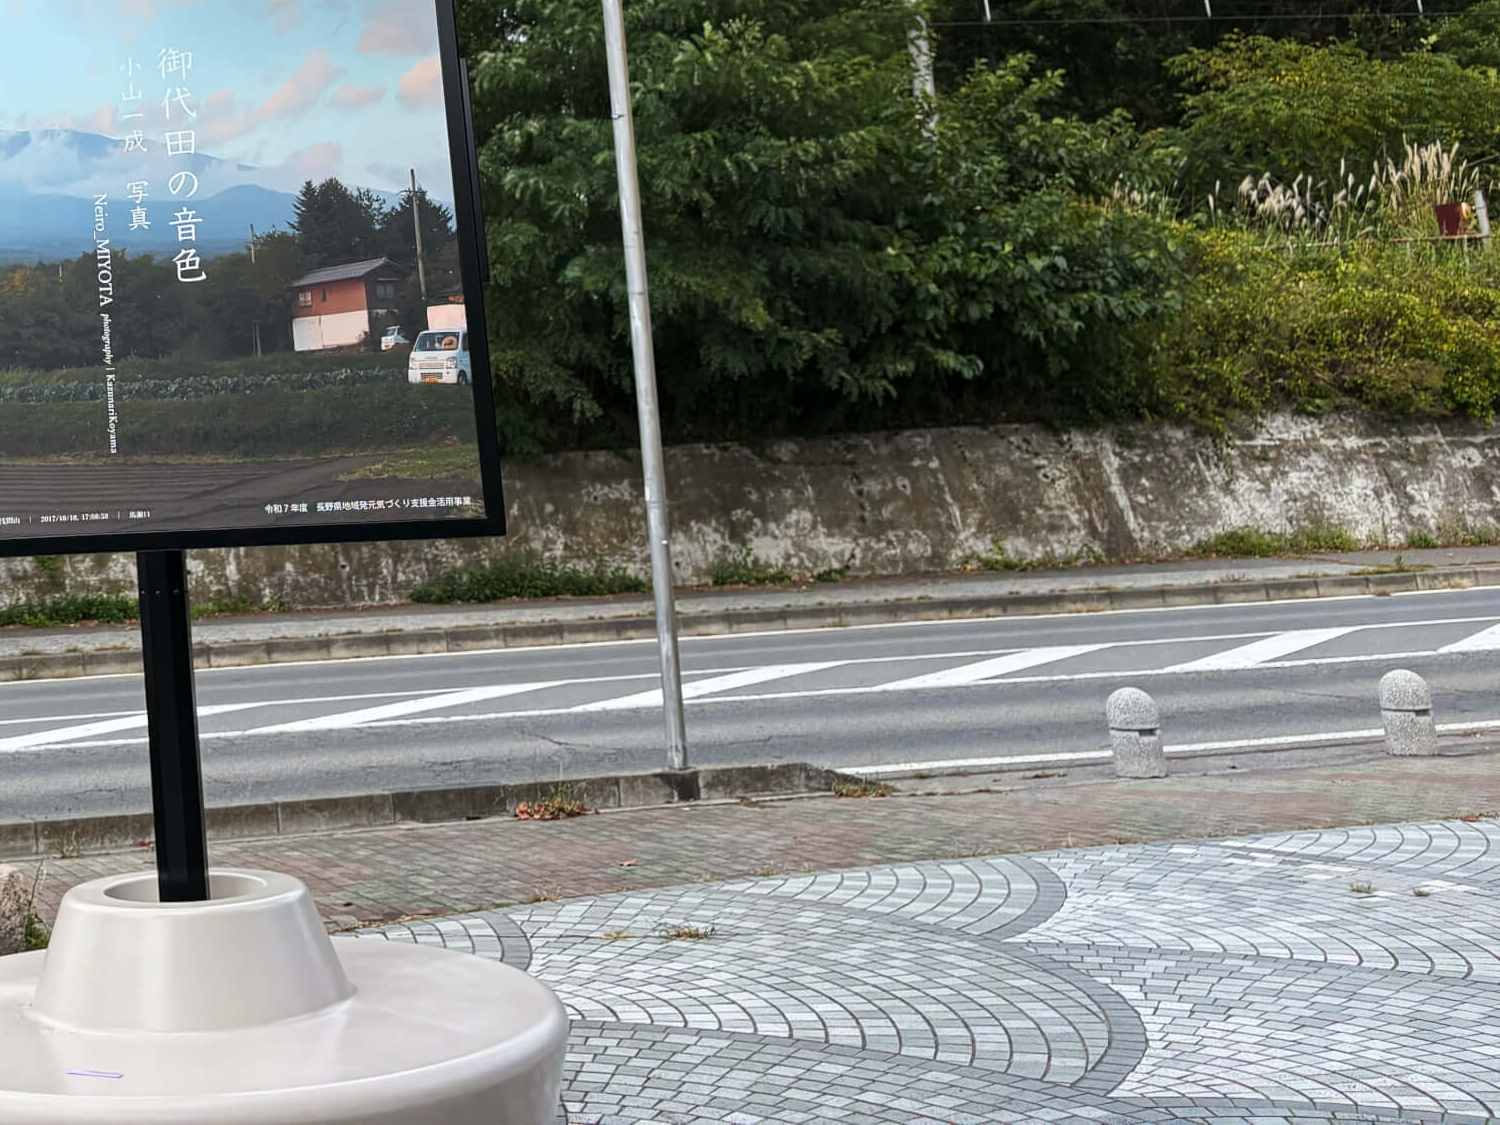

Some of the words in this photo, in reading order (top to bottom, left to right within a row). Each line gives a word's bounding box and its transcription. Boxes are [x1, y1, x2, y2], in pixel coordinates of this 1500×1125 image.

[119, 56, 148, 153] 小山一成
[126, 180, 152, 231] 写真
[157, 47, 207, 283] 御代田の音色
[93, 193, 114, 307] Neiro_MIYOTA
[100, 313, 113, 365] photography
